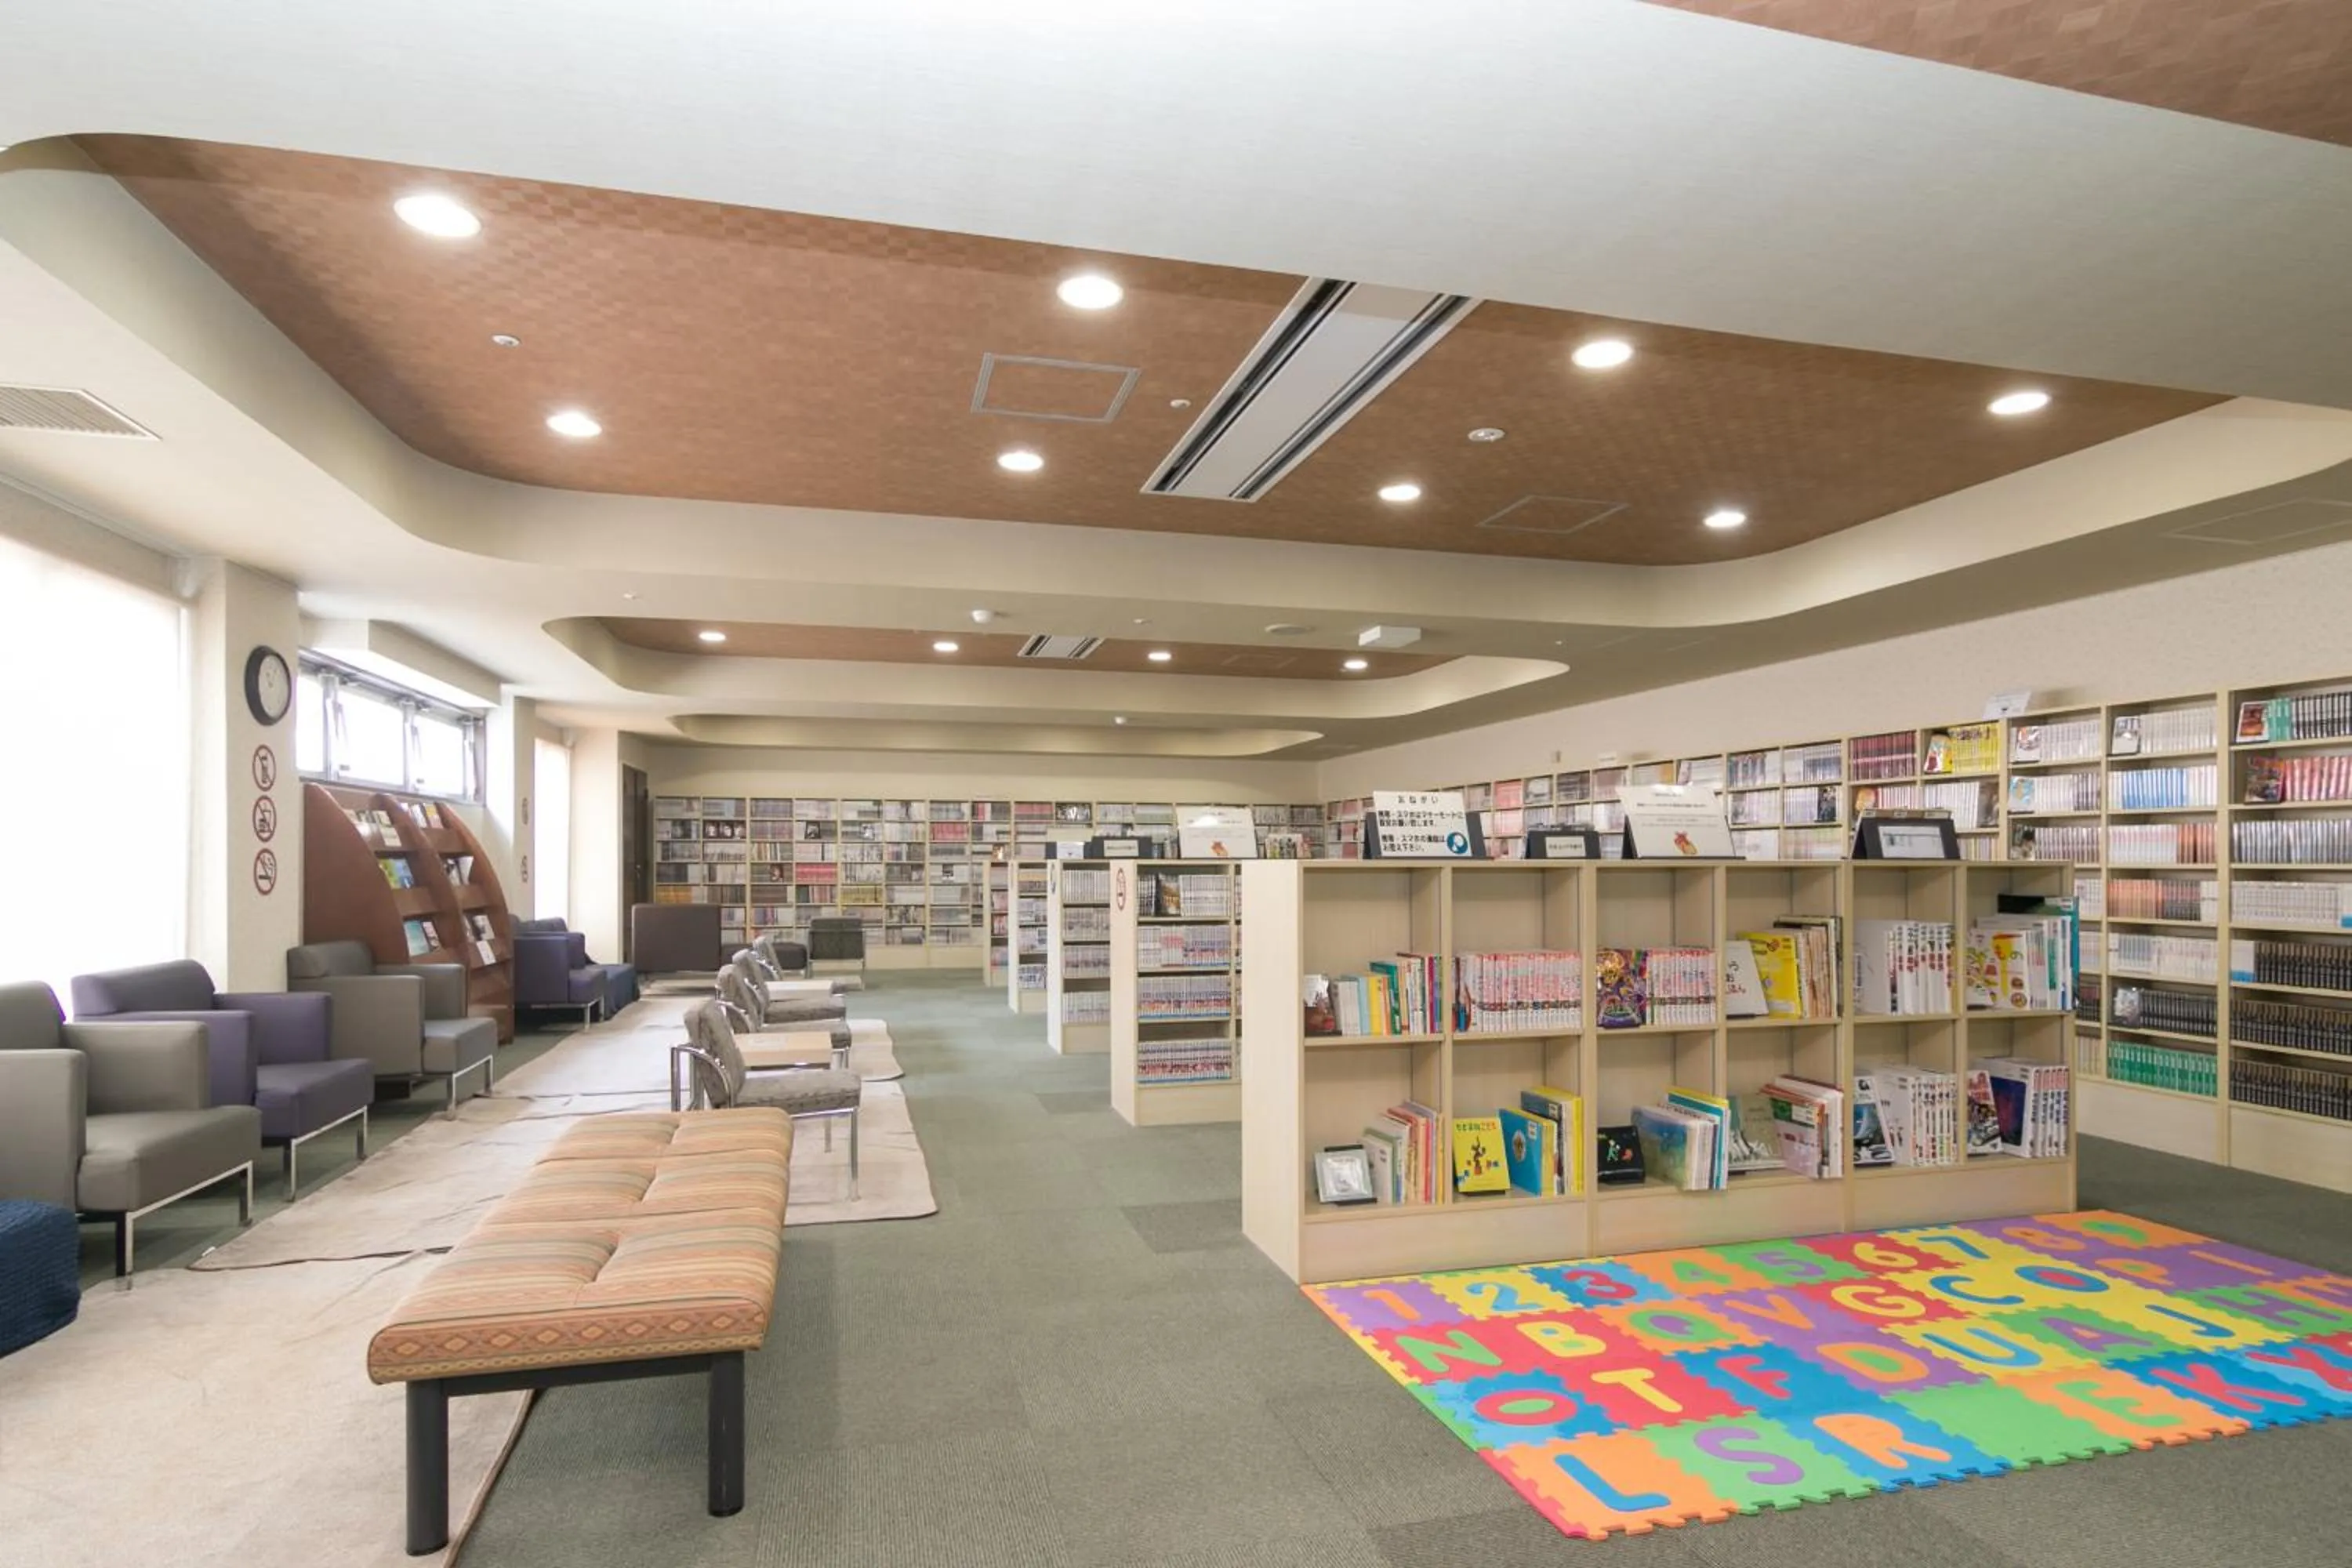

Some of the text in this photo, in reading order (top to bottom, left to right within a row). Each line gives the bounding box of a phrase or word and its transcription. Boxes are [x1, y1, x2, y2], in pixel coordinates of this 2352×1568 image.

[1363, 1221, 2148, 1319] 1 2 3 4 5 6 7 8 9
[1395, 1330, 1503, 1372] N
[1516, 1321, 1607, 1357] B
[1627, 1309, 1737, 1343] Q
[1724, 1295, 1815, 1330] V
[1831, 1286, 1926, 1318] G
[1929, 1275, 2025, 1305] C
[2095, 1258, 2175, 1286] P
[1590, 1368, 1683, 1412] T
[1715, 1356, 1791, 1399] F
[1816, 1342, 1929, 1382] D
[1919, 1328, 2043, 1367] U
[2040, 1317, 2154, 1352] A
[2145, 1305, 2236, 1338] J
[2205, 1291, 2342, 1327] H
[1554, 1454, 1671, 1512] L
[1693, 1426, 1805, 1485] S
[1813, 1414, 1952, 1469] R
[2053, 1381, 2184, 1427] E
[2148, 1363, 2307, 1413] K
